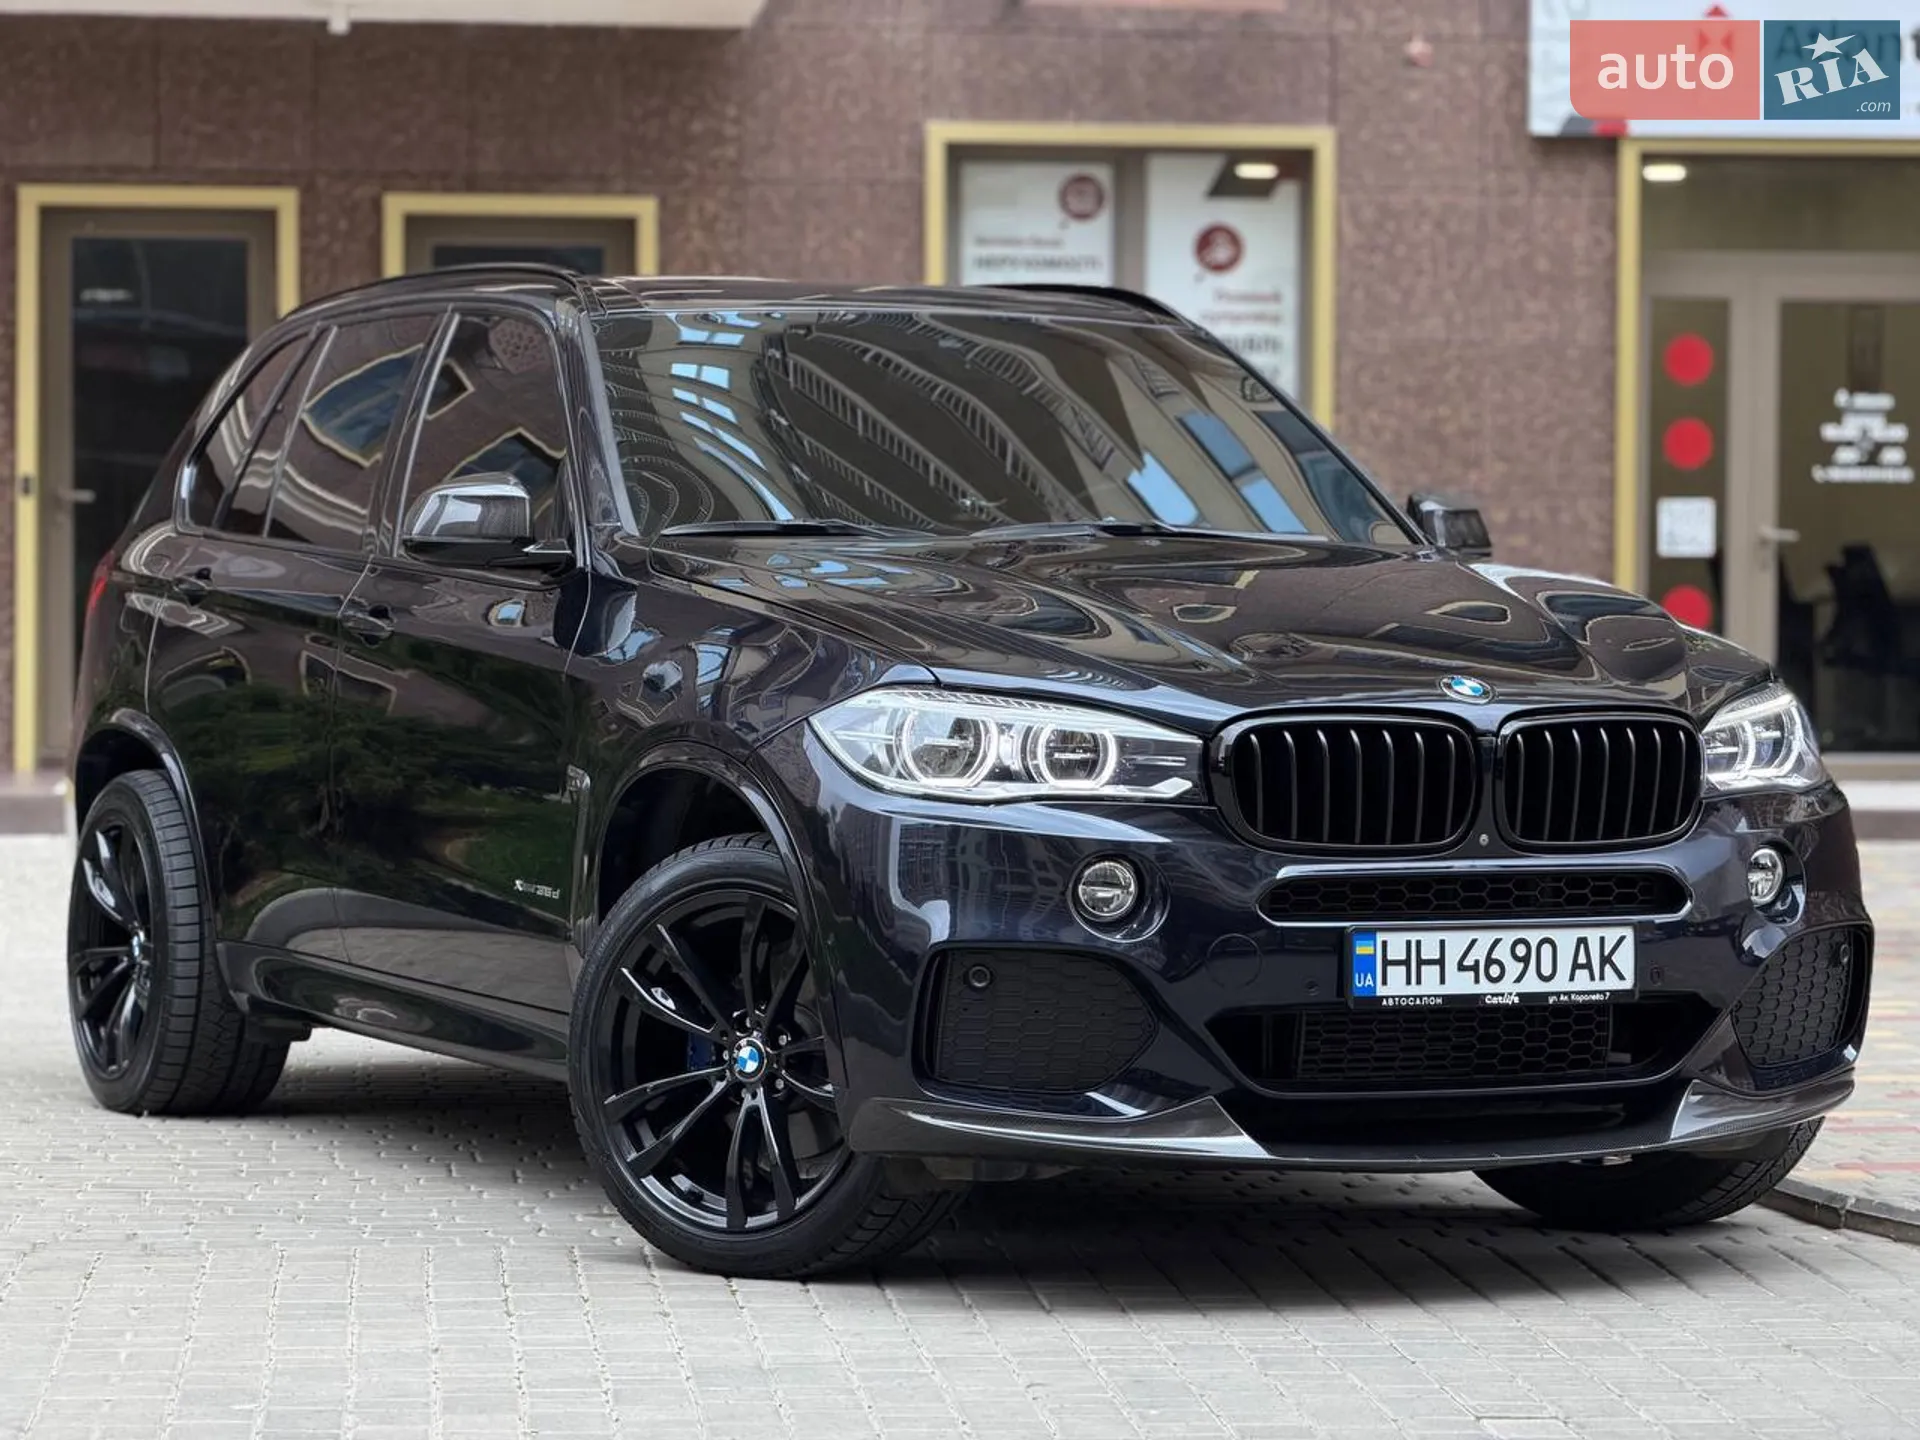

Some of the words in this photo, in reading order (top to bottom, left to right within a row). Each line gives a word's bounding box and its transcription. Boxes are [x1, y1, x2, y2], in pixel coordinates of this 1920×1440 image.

[1381, 938, 1445, 986] HH
[1457, 936, 1558, 985] 4690
[1568, 935, 1627, 982] AK
[1355, 973, 1374, 987] UA
[1381, 996, 1443, 1006] АВТОСАЛОН
